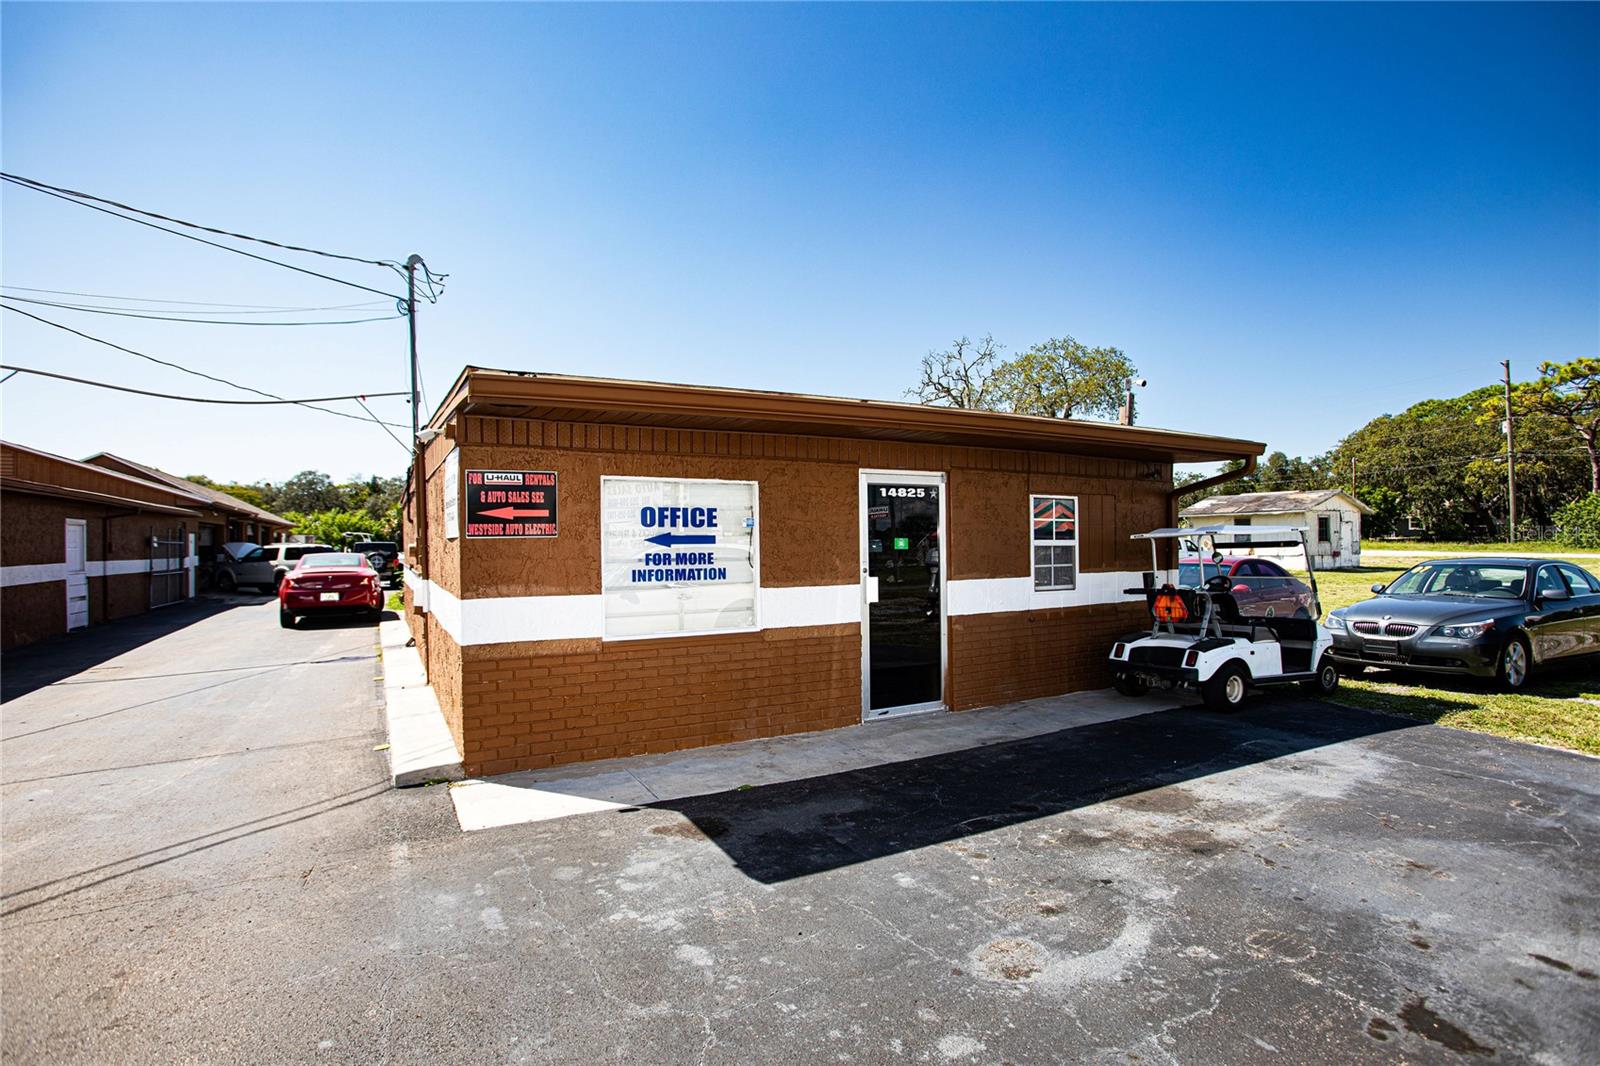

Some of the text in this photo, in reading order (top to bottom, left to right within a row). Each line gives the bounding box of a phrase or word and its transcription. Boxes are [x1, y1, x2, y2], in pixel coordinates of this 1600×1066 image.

[468, 473, 482, 485] FOR
[525, 473, 555, 486] RENTALS
[487, 491, 506, 503] AUTO
[508, 491, 530, 503] SALES
[531, 491, 545, 503] SEE
[879, 487, 925, 498] 14825
[641, 506, 718, 528] OFFICE
[468, 523, 556, 535] WESTSIDE AUTO ELECTRIC
[645, 552, 714, 566] FOR MORE
[632, 567, 727, 582] INFORMATION
